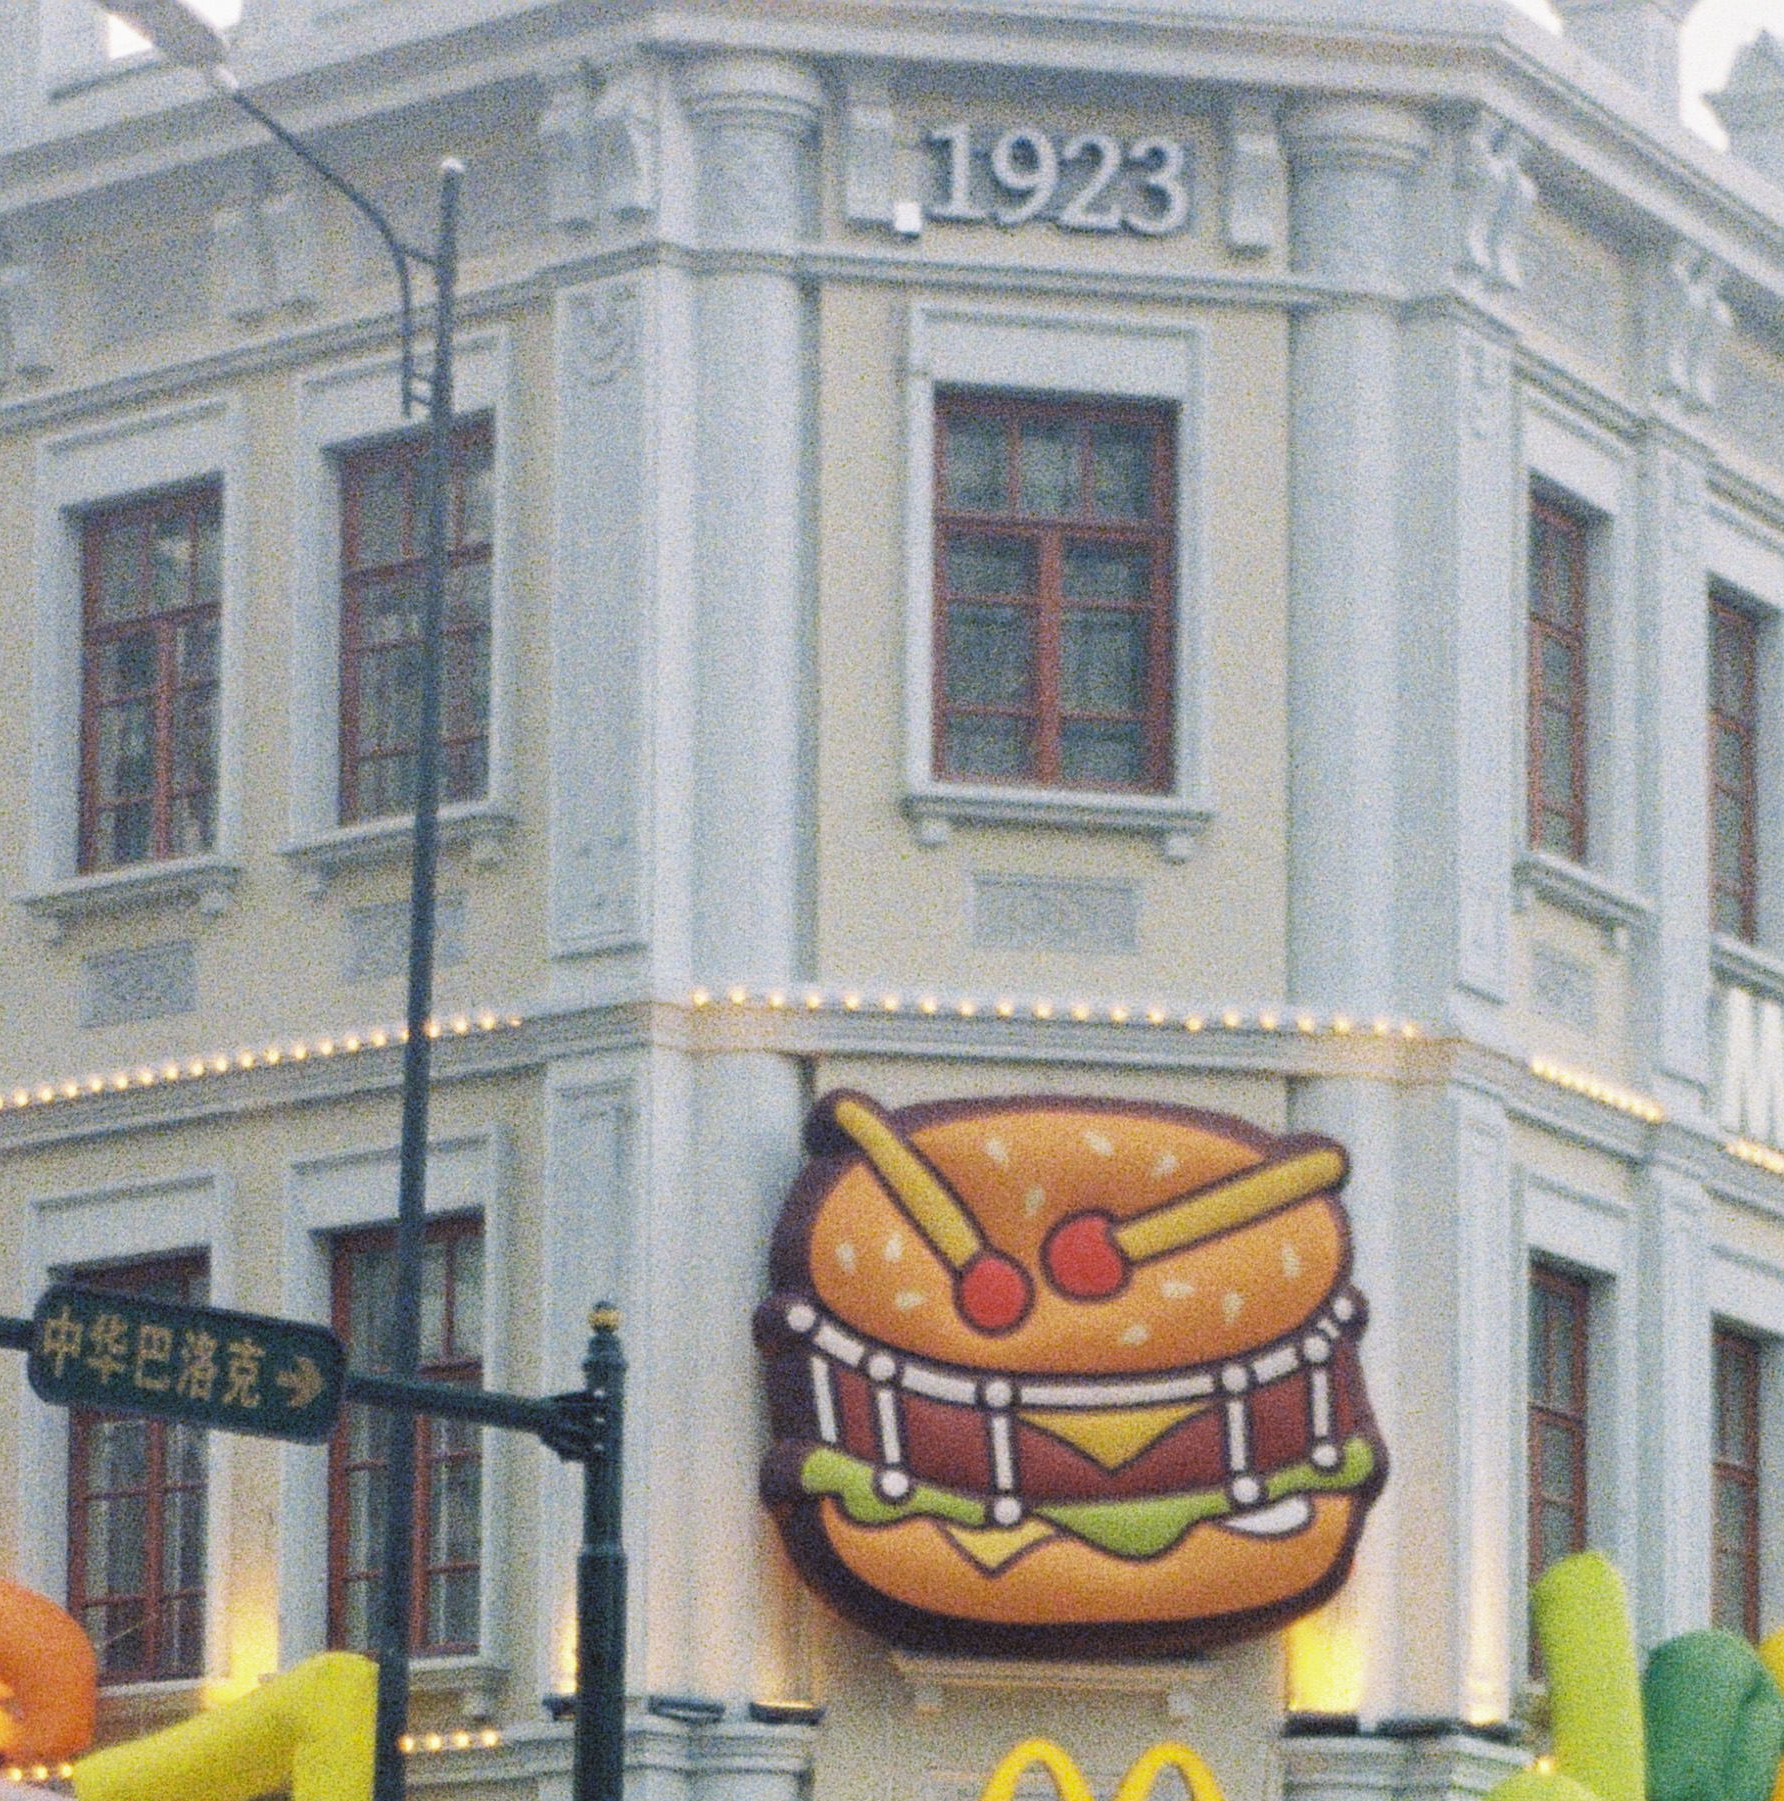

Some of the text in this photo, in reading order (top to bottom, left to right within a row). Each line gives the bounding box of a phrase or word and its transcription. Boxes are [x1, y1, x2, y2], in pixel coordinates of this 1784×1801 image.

[922, 120, 1191, 237] 1923
[41, 1305, 267, 1410] 中华巴洛克
